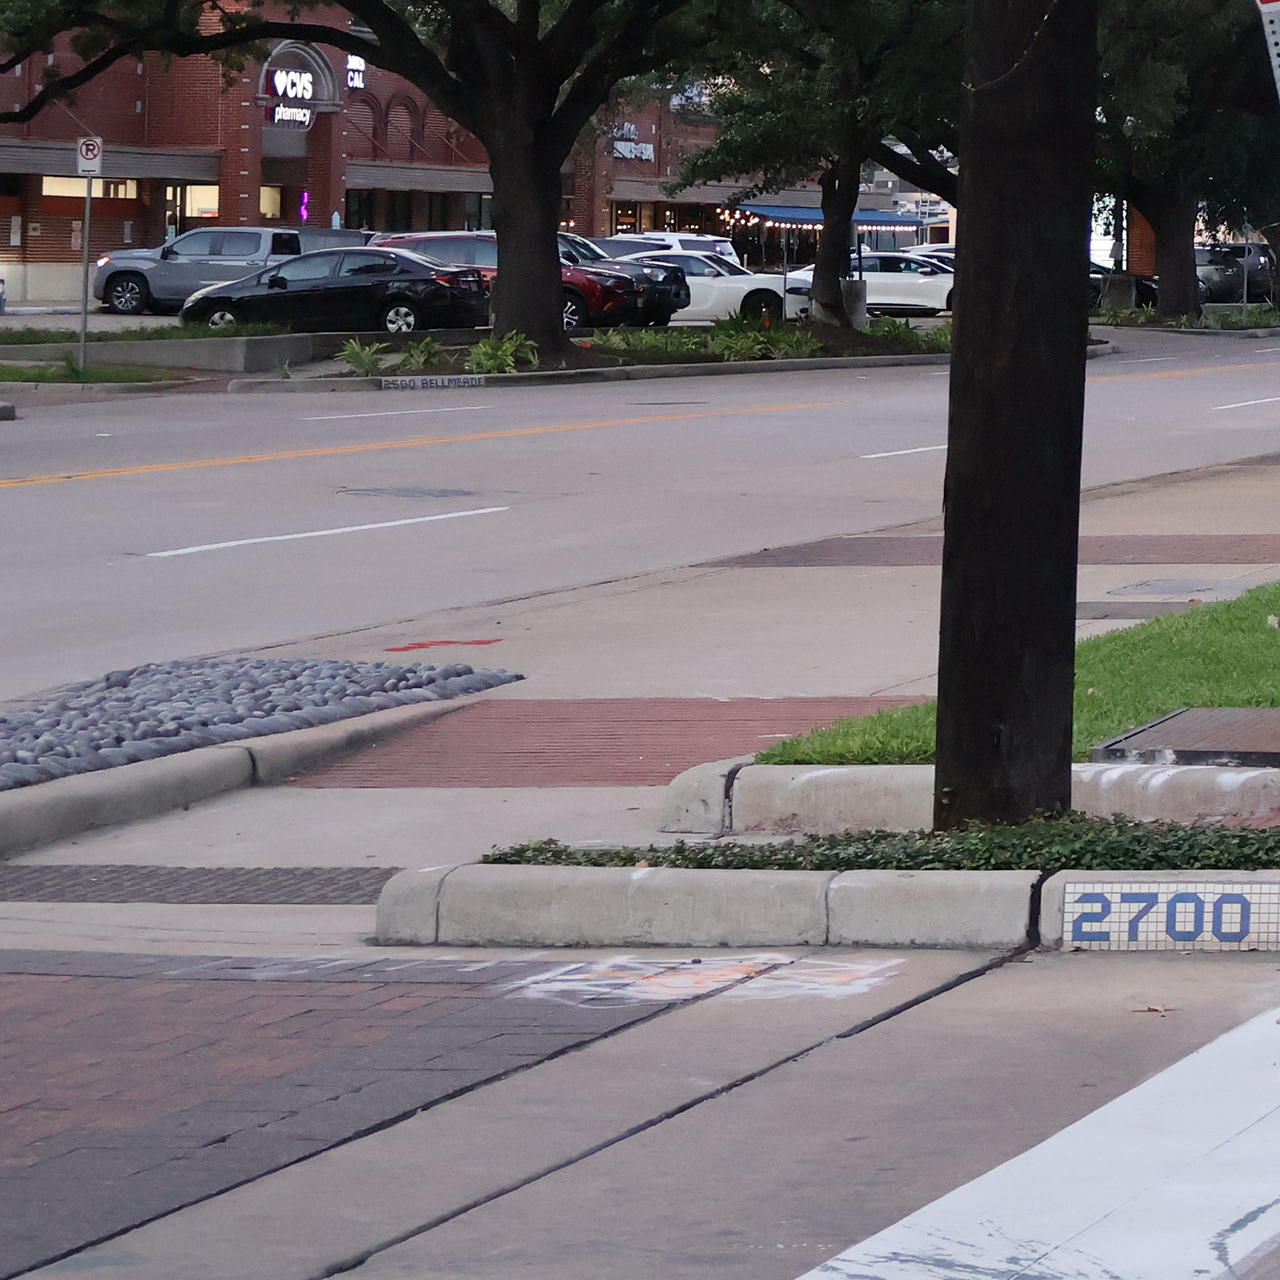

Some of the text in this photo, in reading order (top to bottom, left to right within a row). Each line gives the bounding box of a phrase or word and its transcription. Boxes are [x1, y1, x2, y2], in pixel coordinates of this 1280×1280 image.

[286, 70, 313, 100] CVS
[274, 102, 311, 126] pharmacy
[383, 377, 482, 390] 2500 BELLMEADE
[1072, 893, 1251, 941] 2700
